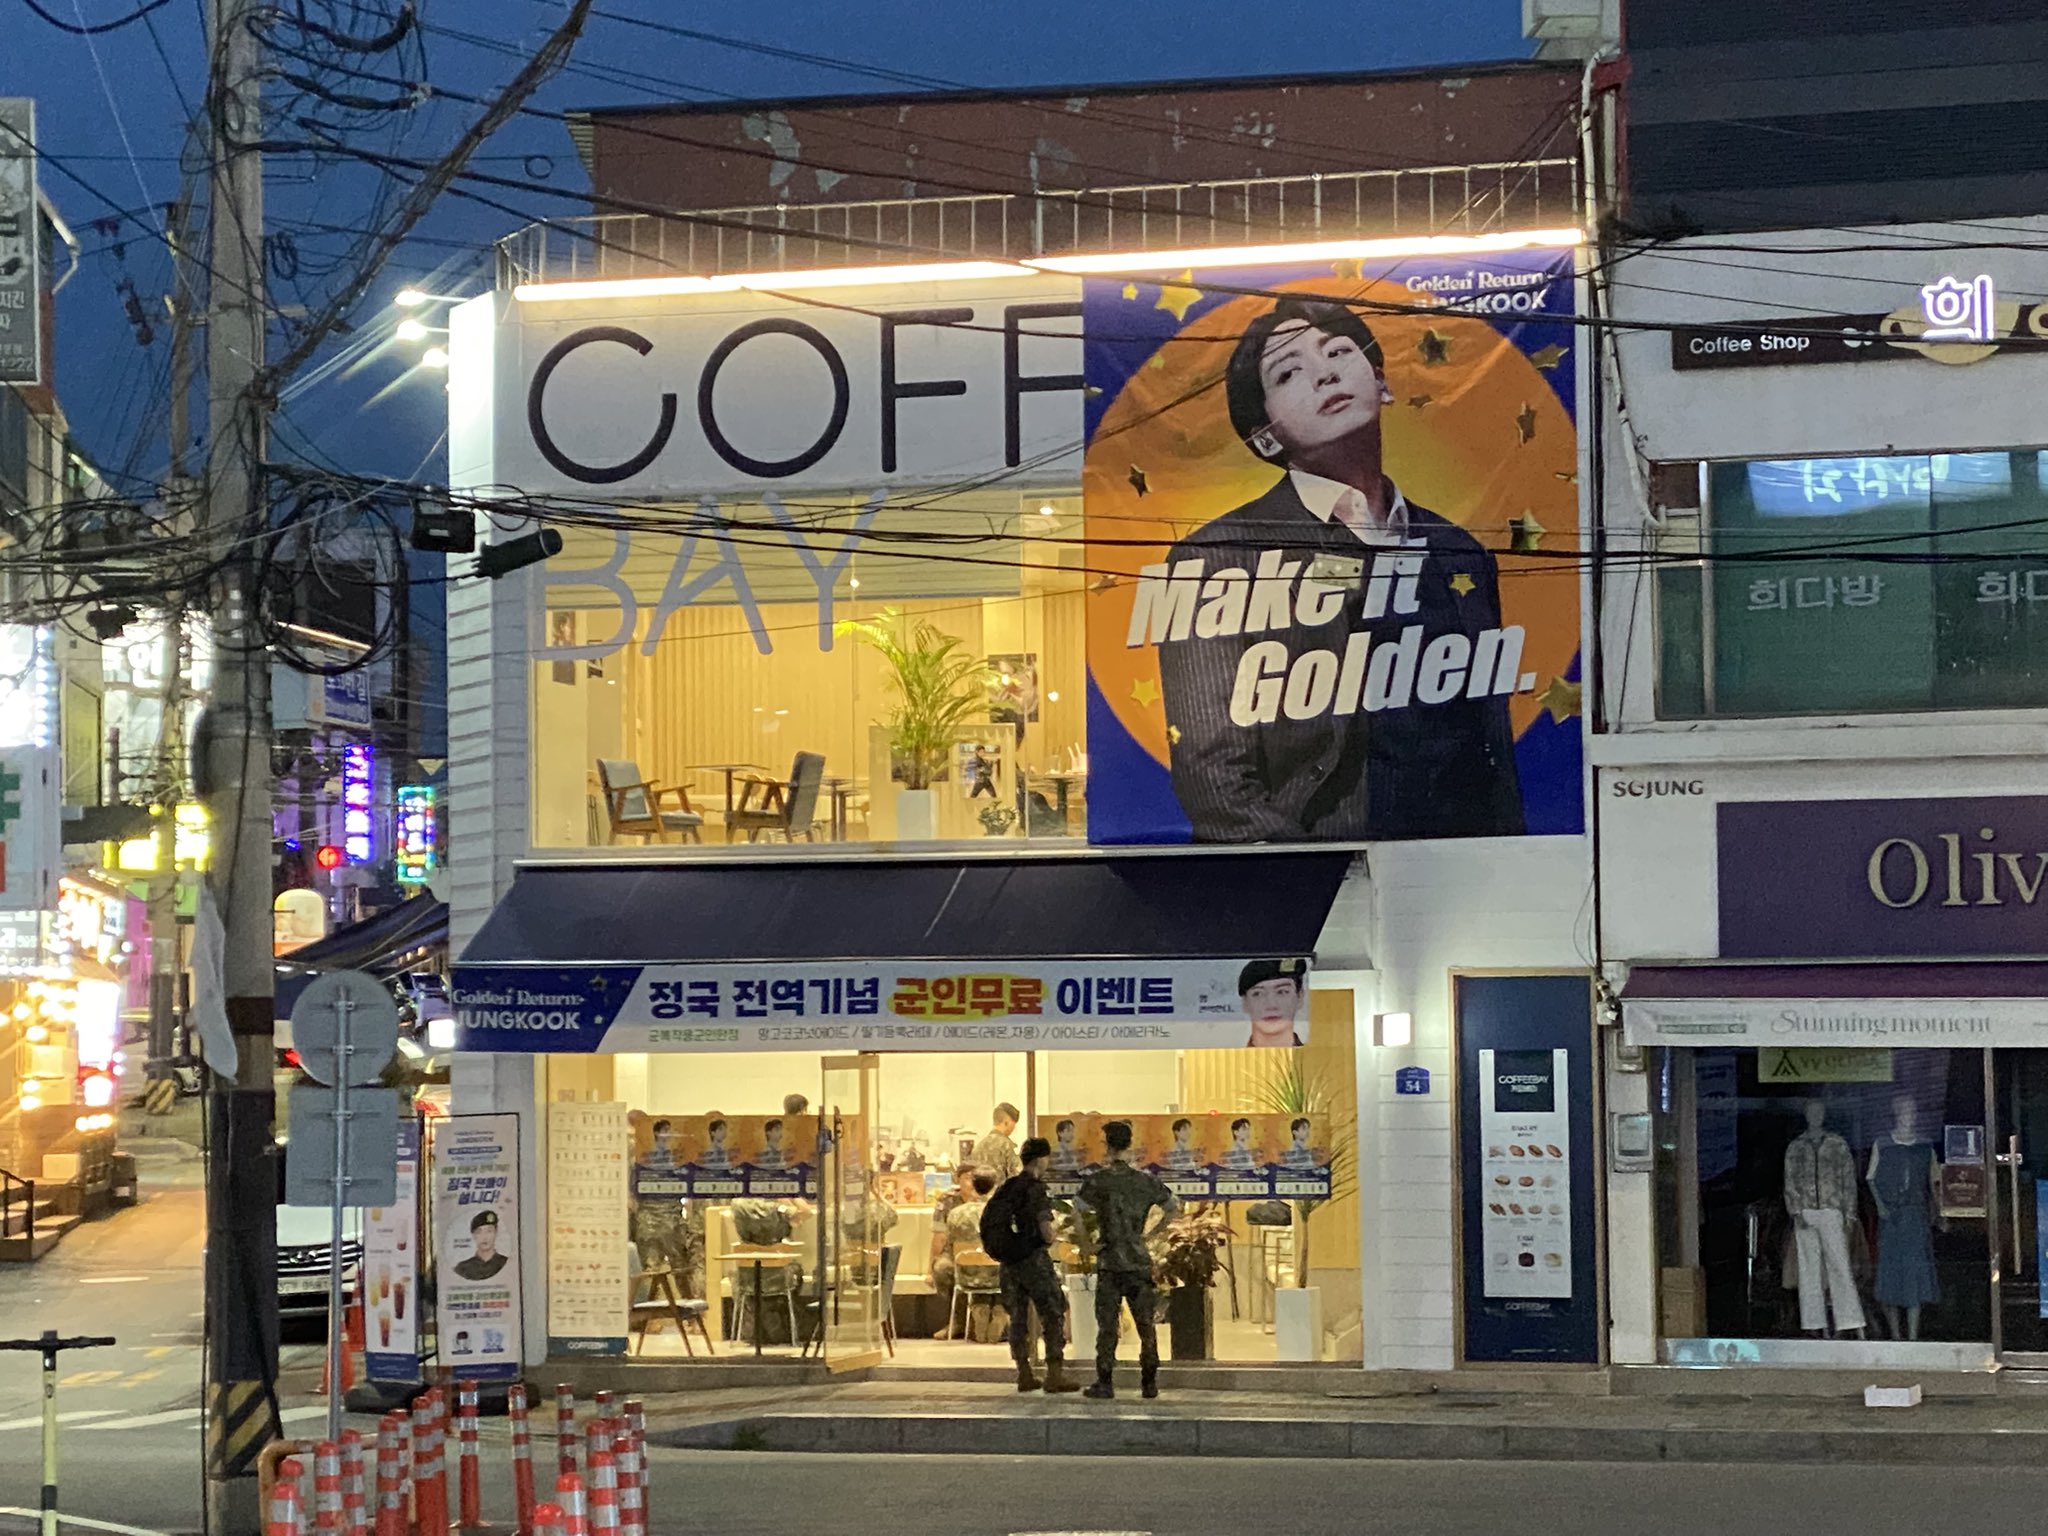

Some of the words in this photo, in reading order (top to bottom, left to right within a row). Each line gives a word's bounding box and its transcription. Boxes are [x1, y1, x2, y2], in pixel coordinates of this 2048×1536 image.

[1405, 274, 1473, 293] Golden
[1411, 289, 1547, 317] NGKOOK
[1690, 336, 1753, 355] Coffee
[1760, 333, 1811, 351] Shop
[528, 487, 891, 662] BAY
[1127, 550, 1346, 648] Make
[1748, 574, 1885, 610] 희다방
[1230, 624, 1536, 728] Golden.
[1868, 827, 2048, 910] Oliv
[453, 989, 512, 1004] Golden
[649, 980, 720, 1019] 정국
[732, 977, 880, 1018] 전역기념
[893, 977, 1043, 1016] 군인무료
[1056, 977, 1175, 1015] 이벤트
[1110, 1025, 1171, 1039] 아메리카노
[1405, 1080, 1421, 1092] 54
